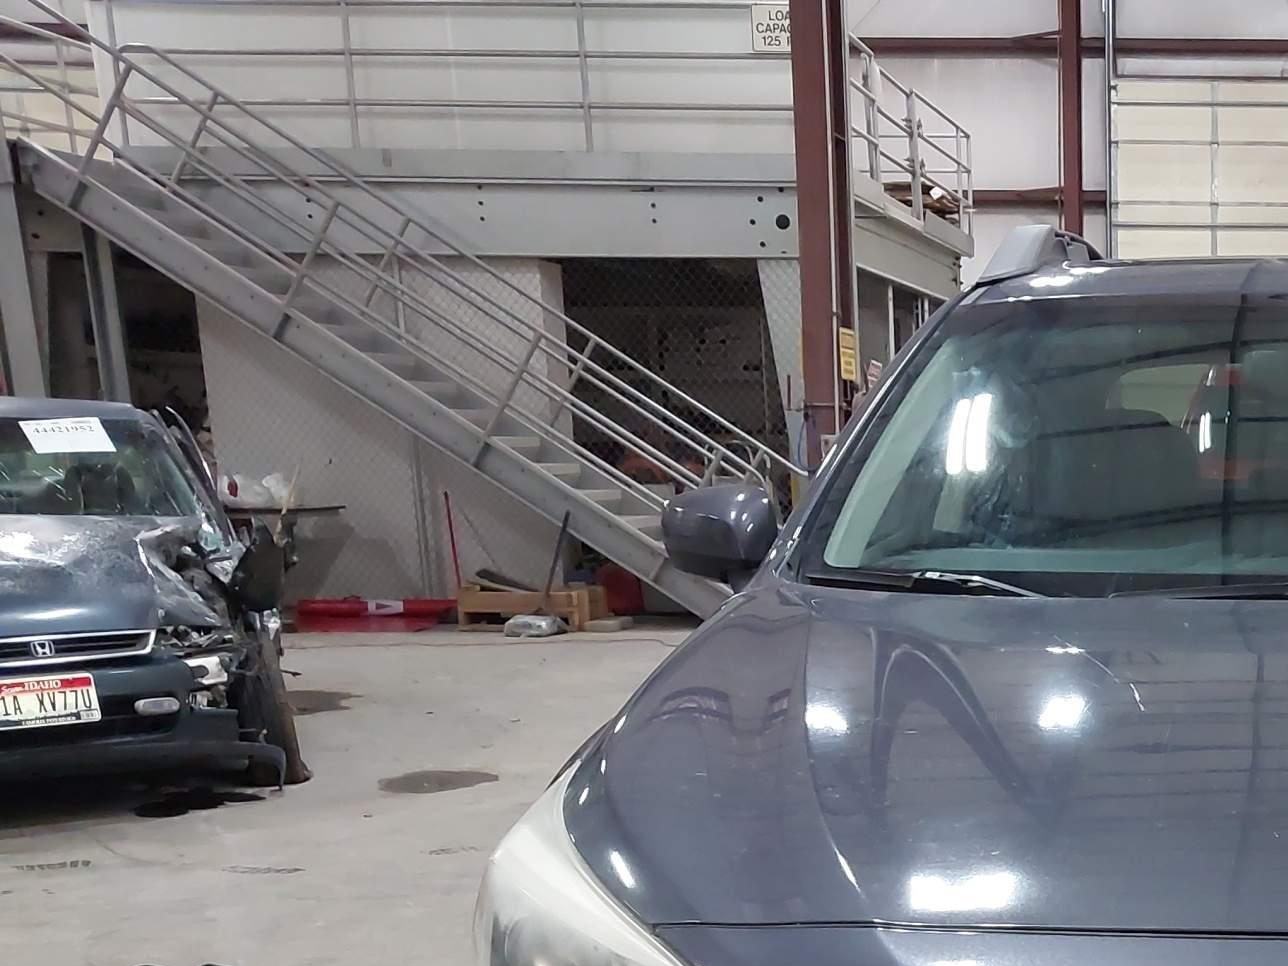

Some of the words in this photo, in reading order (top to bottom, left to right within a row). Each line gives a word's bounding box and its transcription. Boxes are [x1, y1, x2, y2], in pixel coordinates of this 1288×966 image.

[761, 35, 781, 46] 125
[24, 679, 62, 691] IDAHO
[0, 694, 23, 717] 1A
[36, 688, 92, 713] XV77U
